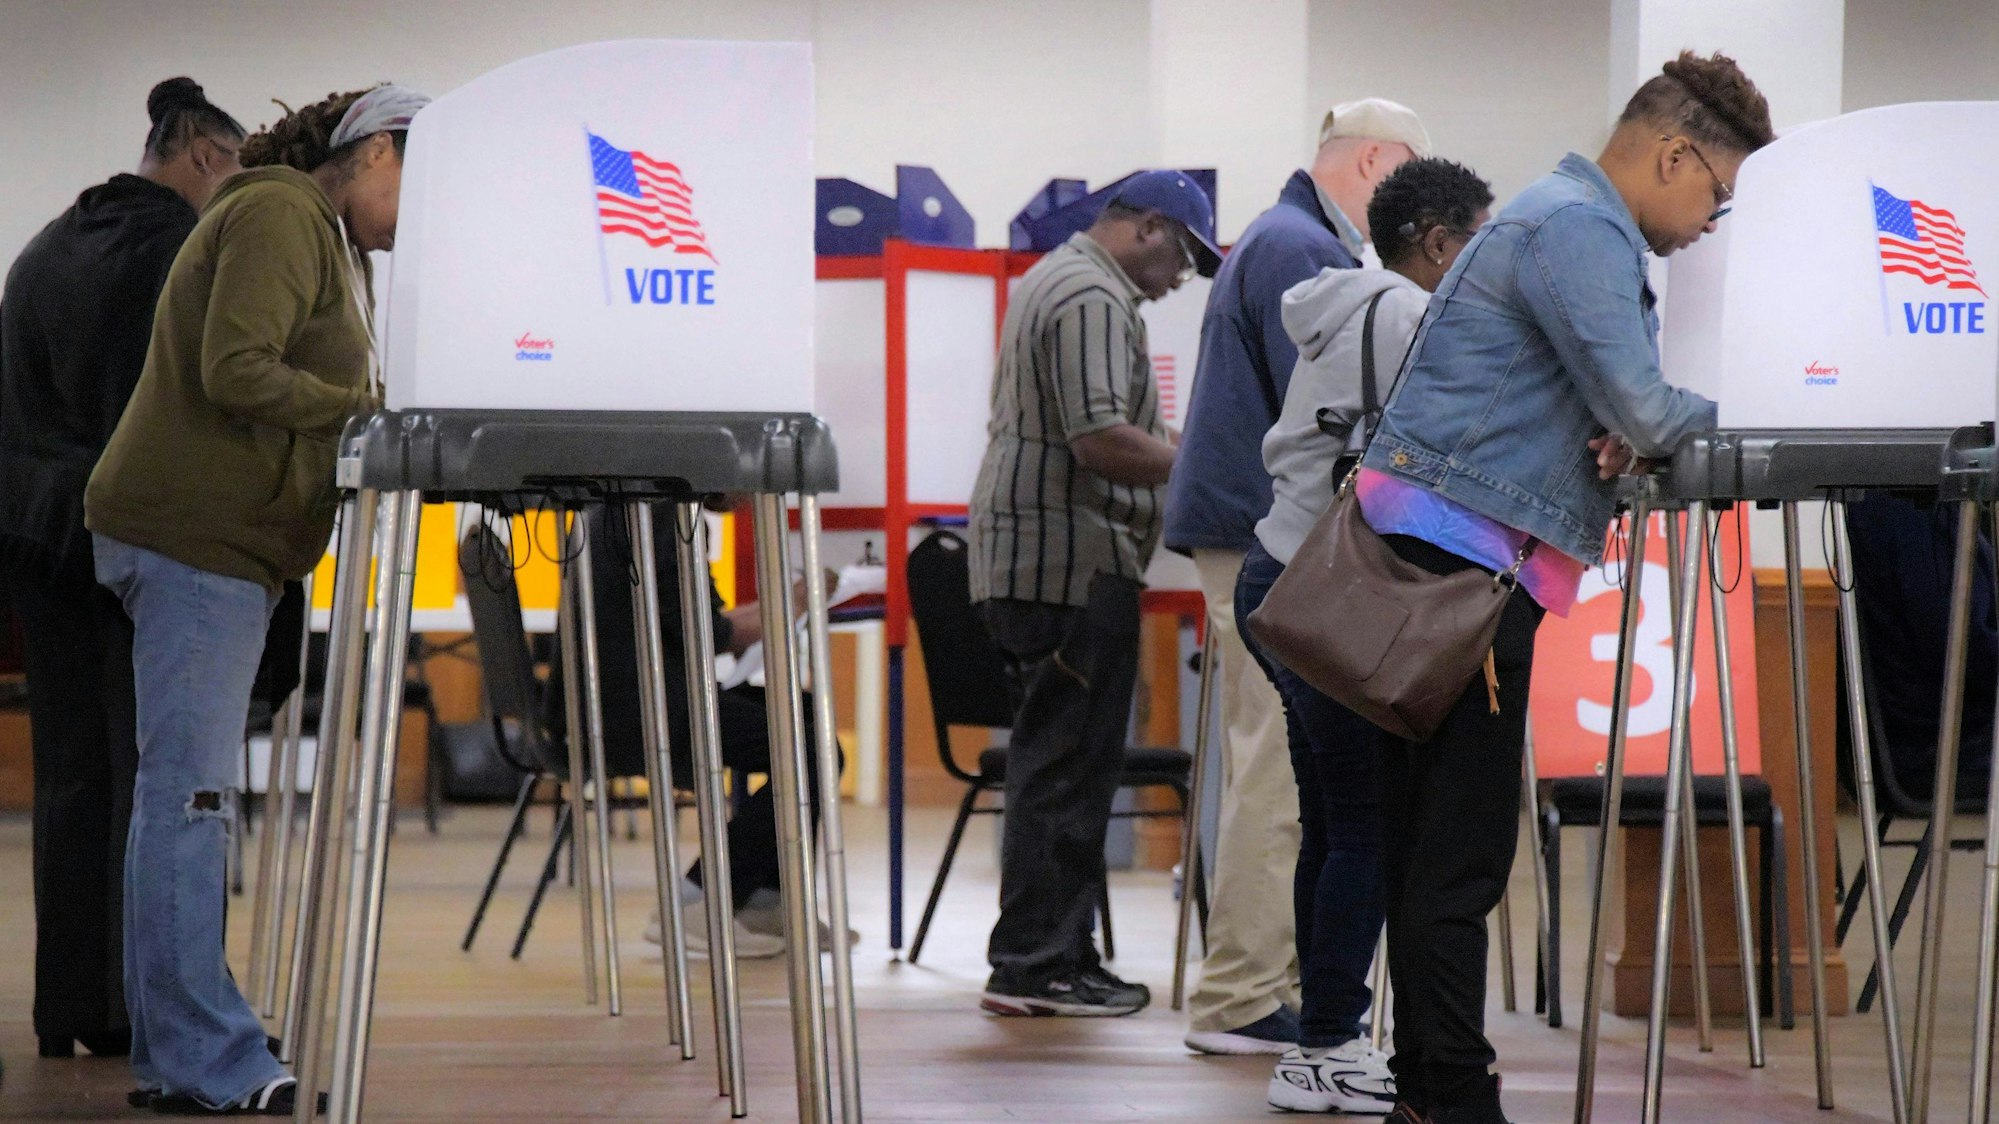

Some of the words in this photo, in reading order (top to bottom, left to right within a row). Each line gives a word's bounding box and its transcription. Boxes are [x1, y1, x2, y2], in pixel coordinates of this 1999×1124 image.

[625, 268, 715, 305] VOTE
[1903, 302, 1985, 334] VOTE
[514, 331, 555, 349] Voter's
[515, 350, 552, 361] choice
[1804, 360, 1839, 375] Voter's
[1805, 376, 1837, 385] choice
[1575, 560, 1697, 737] 3
